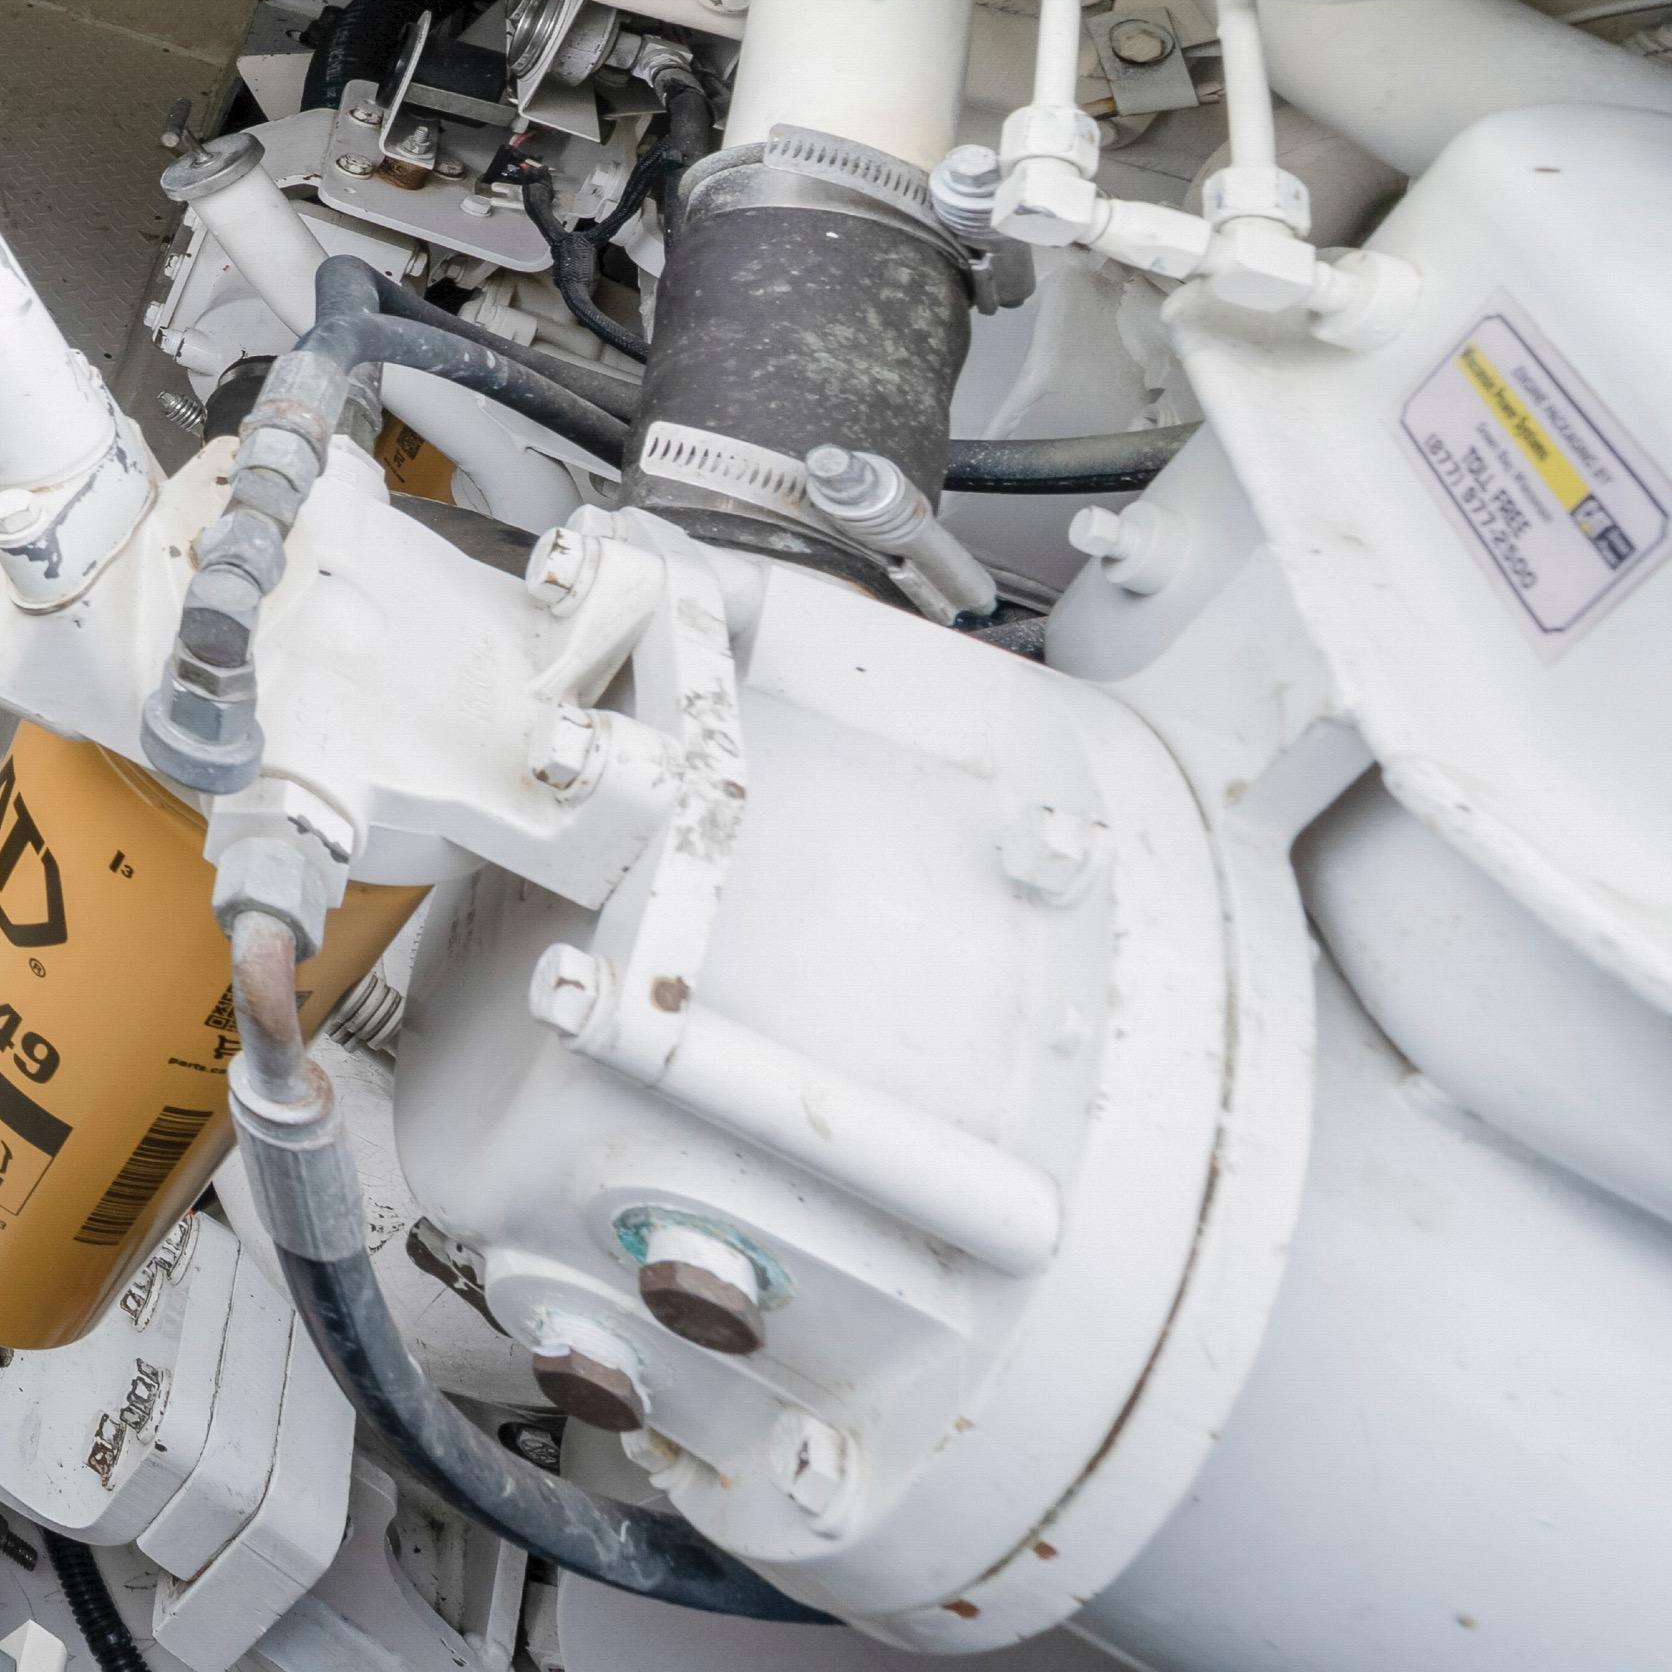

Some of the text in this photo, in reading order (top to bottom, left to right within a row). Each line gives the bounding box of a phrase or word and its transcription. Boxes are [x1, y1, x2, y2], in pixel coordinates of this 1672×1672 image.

[1461, 487, 1538, 589] 977-2500
[1463, 444, 1532, 540] TOLL FREE
